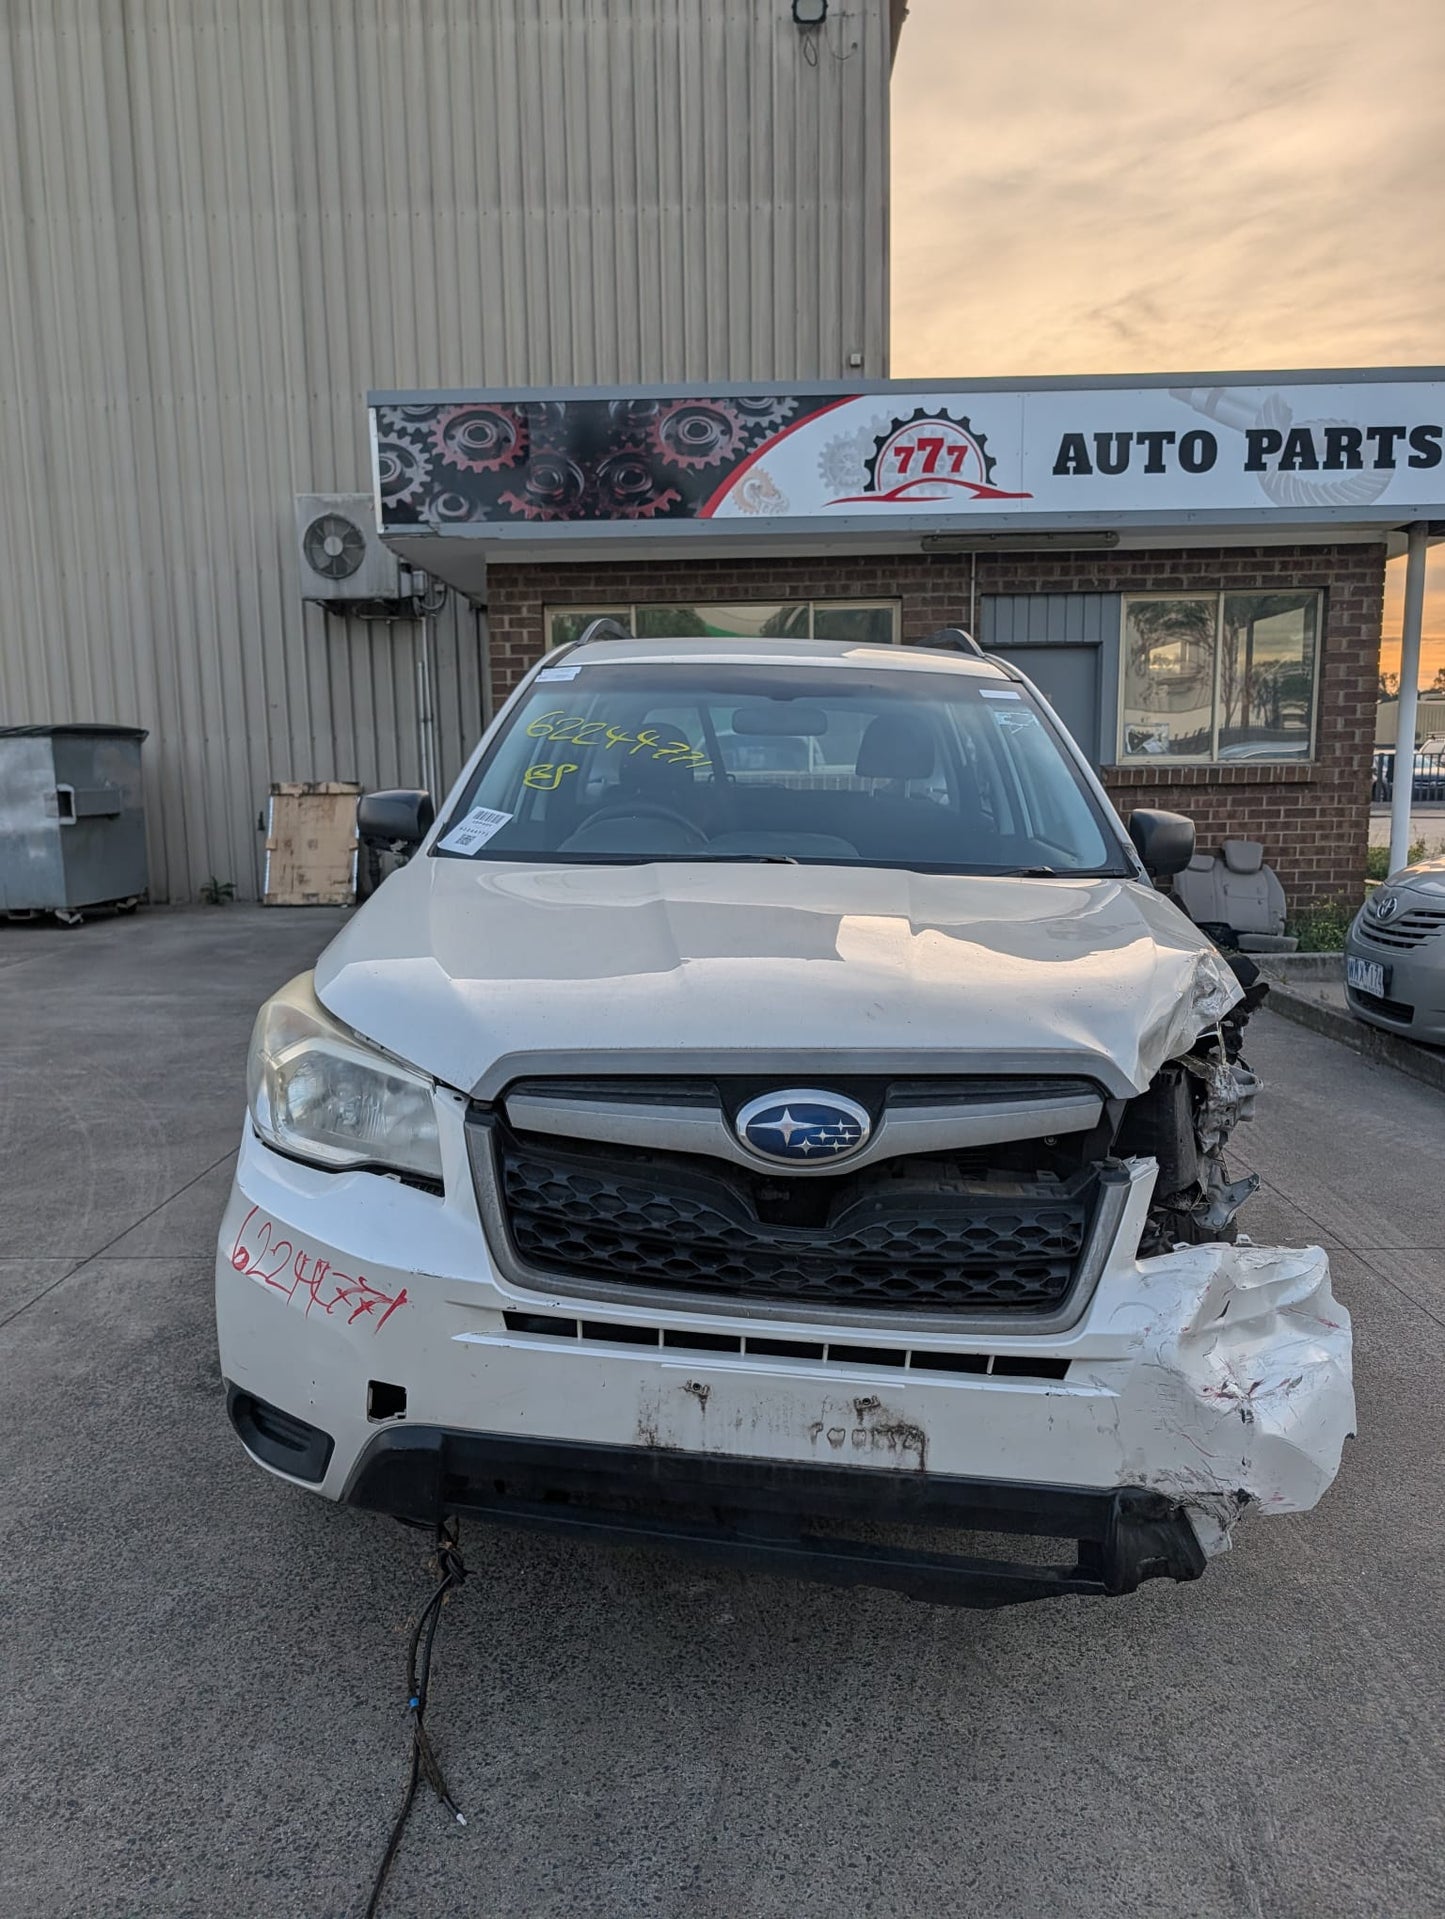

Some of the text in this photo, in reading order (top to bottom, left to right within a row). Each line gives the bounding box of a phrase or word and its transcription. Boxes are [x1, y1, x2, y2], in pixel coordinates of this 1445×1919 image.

[894, 437, 968, 474] 777
[1052, 425, 1443, 475] AUTO PARTS
